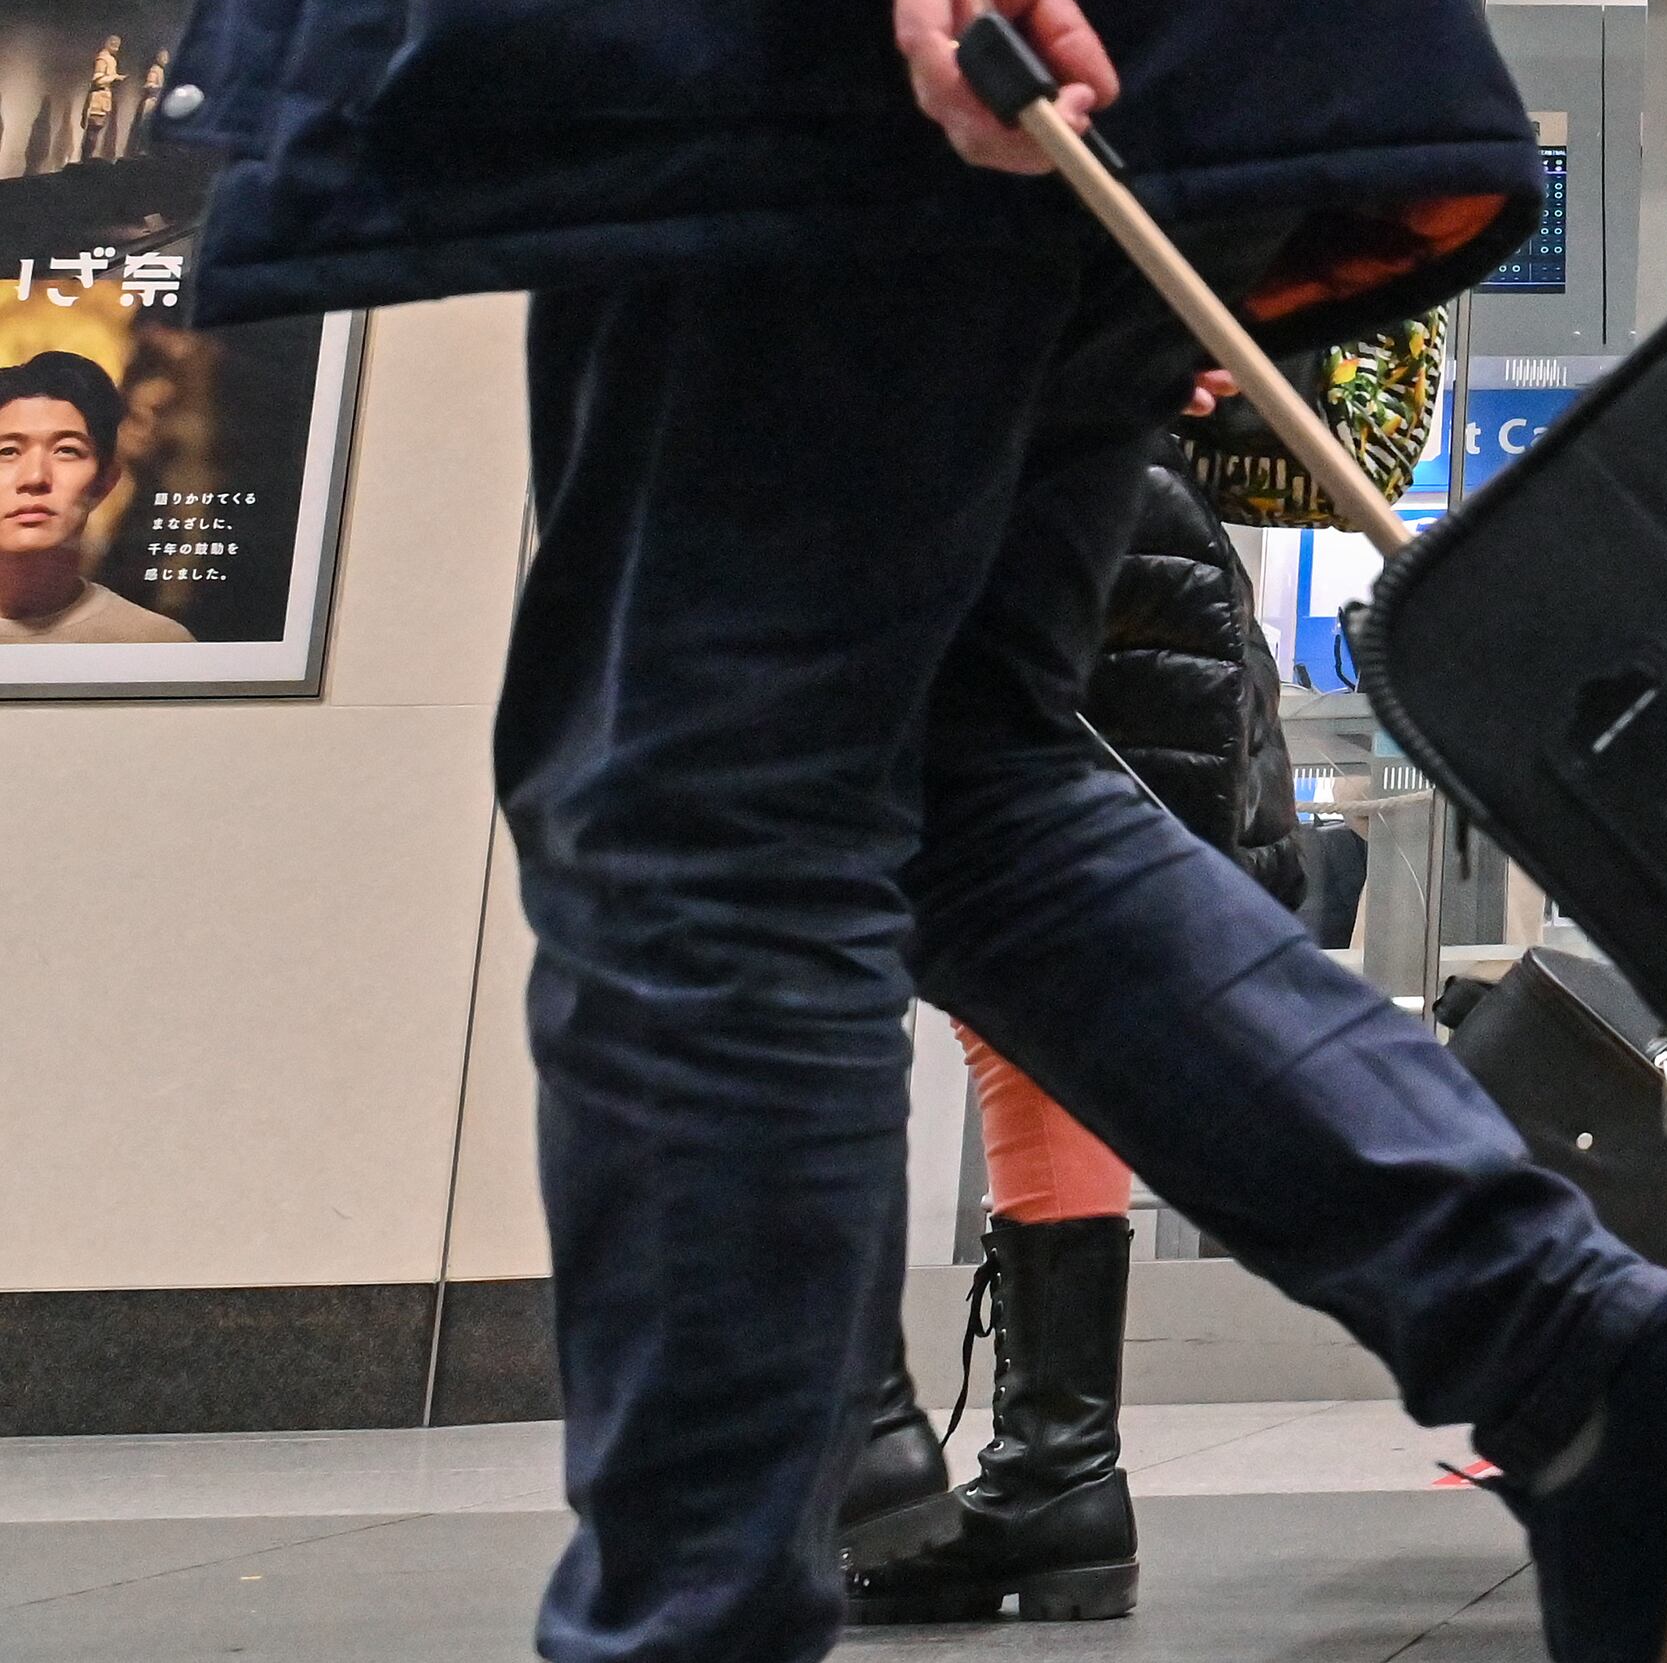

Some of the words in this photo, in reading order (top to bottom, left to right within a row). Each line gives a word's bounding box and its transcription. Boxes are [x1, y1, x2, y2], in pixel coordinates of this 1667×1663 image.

[152, 517, 233, 530] まなざしに、
